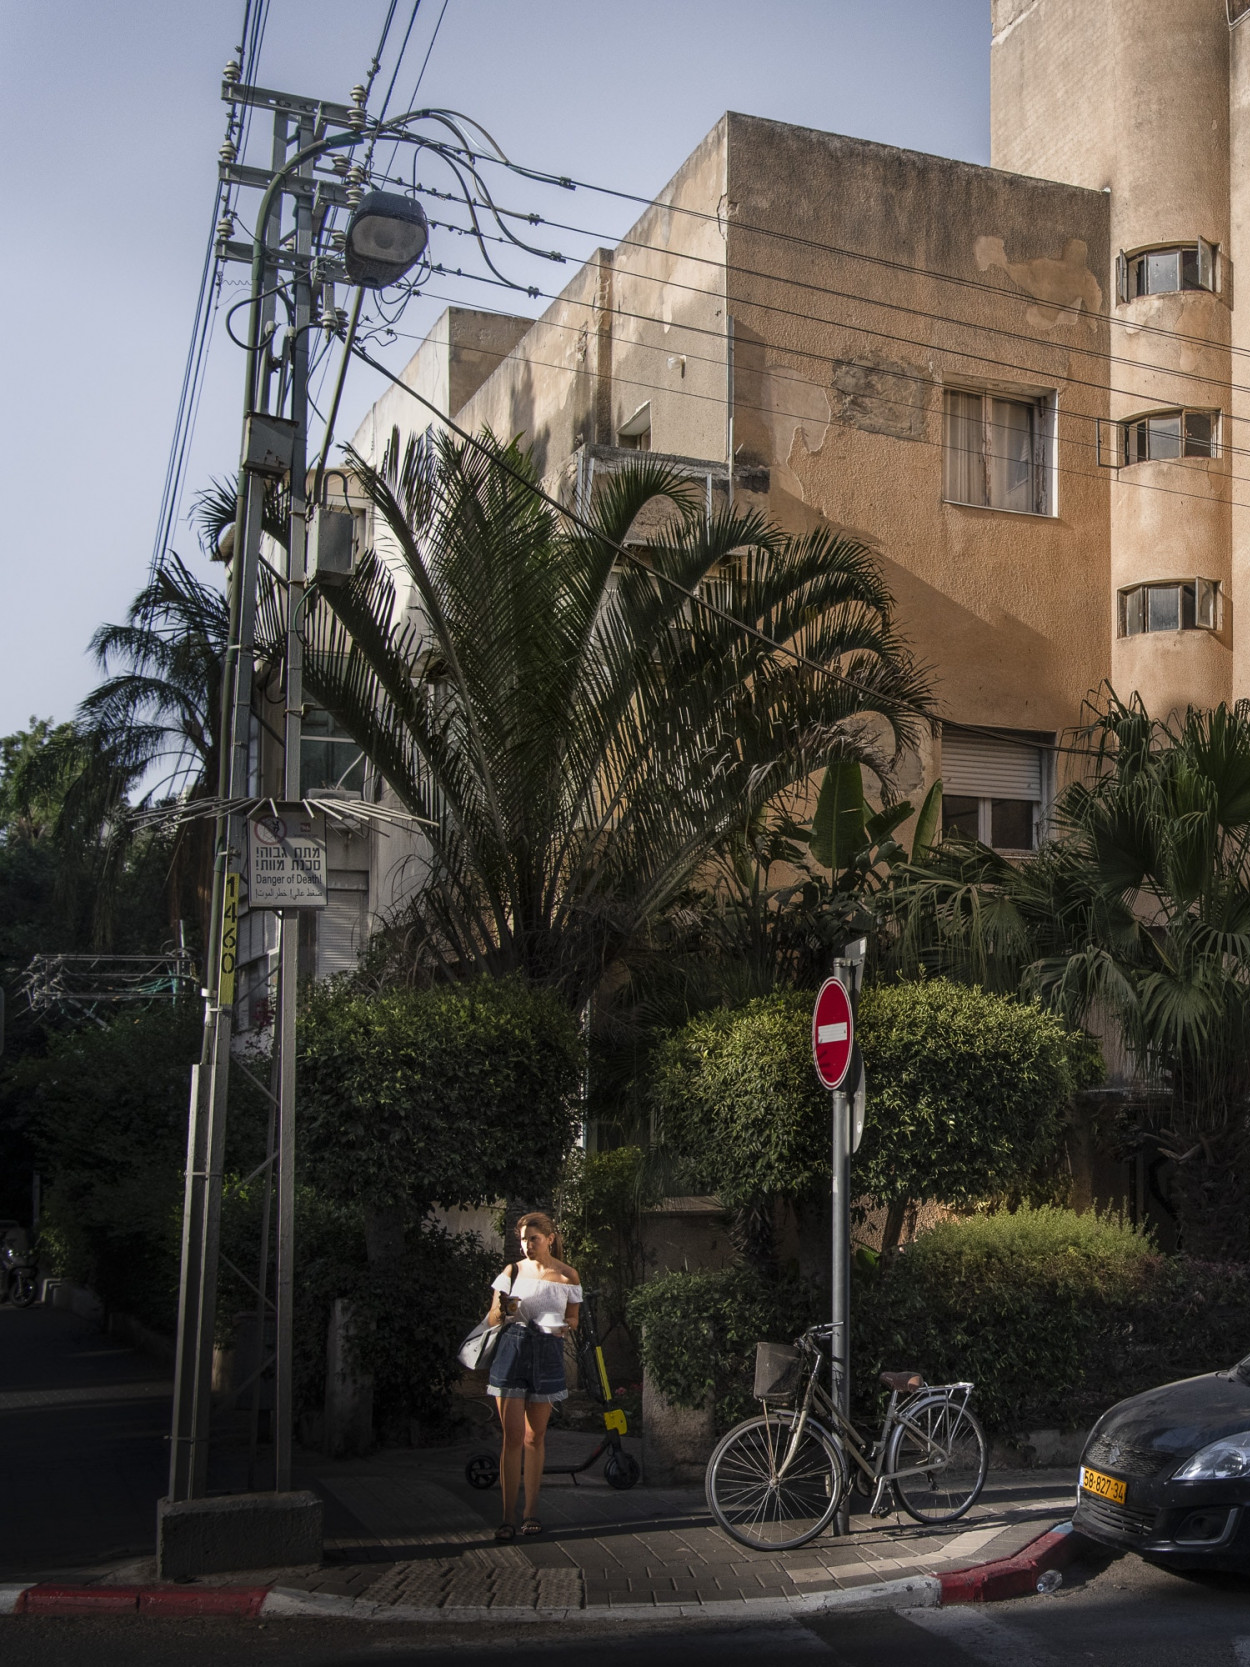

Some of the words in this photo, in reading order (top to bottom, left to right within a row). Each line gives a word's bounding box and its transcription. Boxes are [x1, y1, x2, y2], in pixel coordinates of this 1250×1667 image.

[256, 847, 288, 858] גבוה!
[294, 847, 320, 858] מתח
[256, 859, 285, 871] מוות!
[291, 859, 321, 871] סכנת
[256, 874, 285, 886] Danger
[286, 874, 295, 884] of
[297, 874, 322, 884] Death!
[222, 876, 237, 974] 1460
